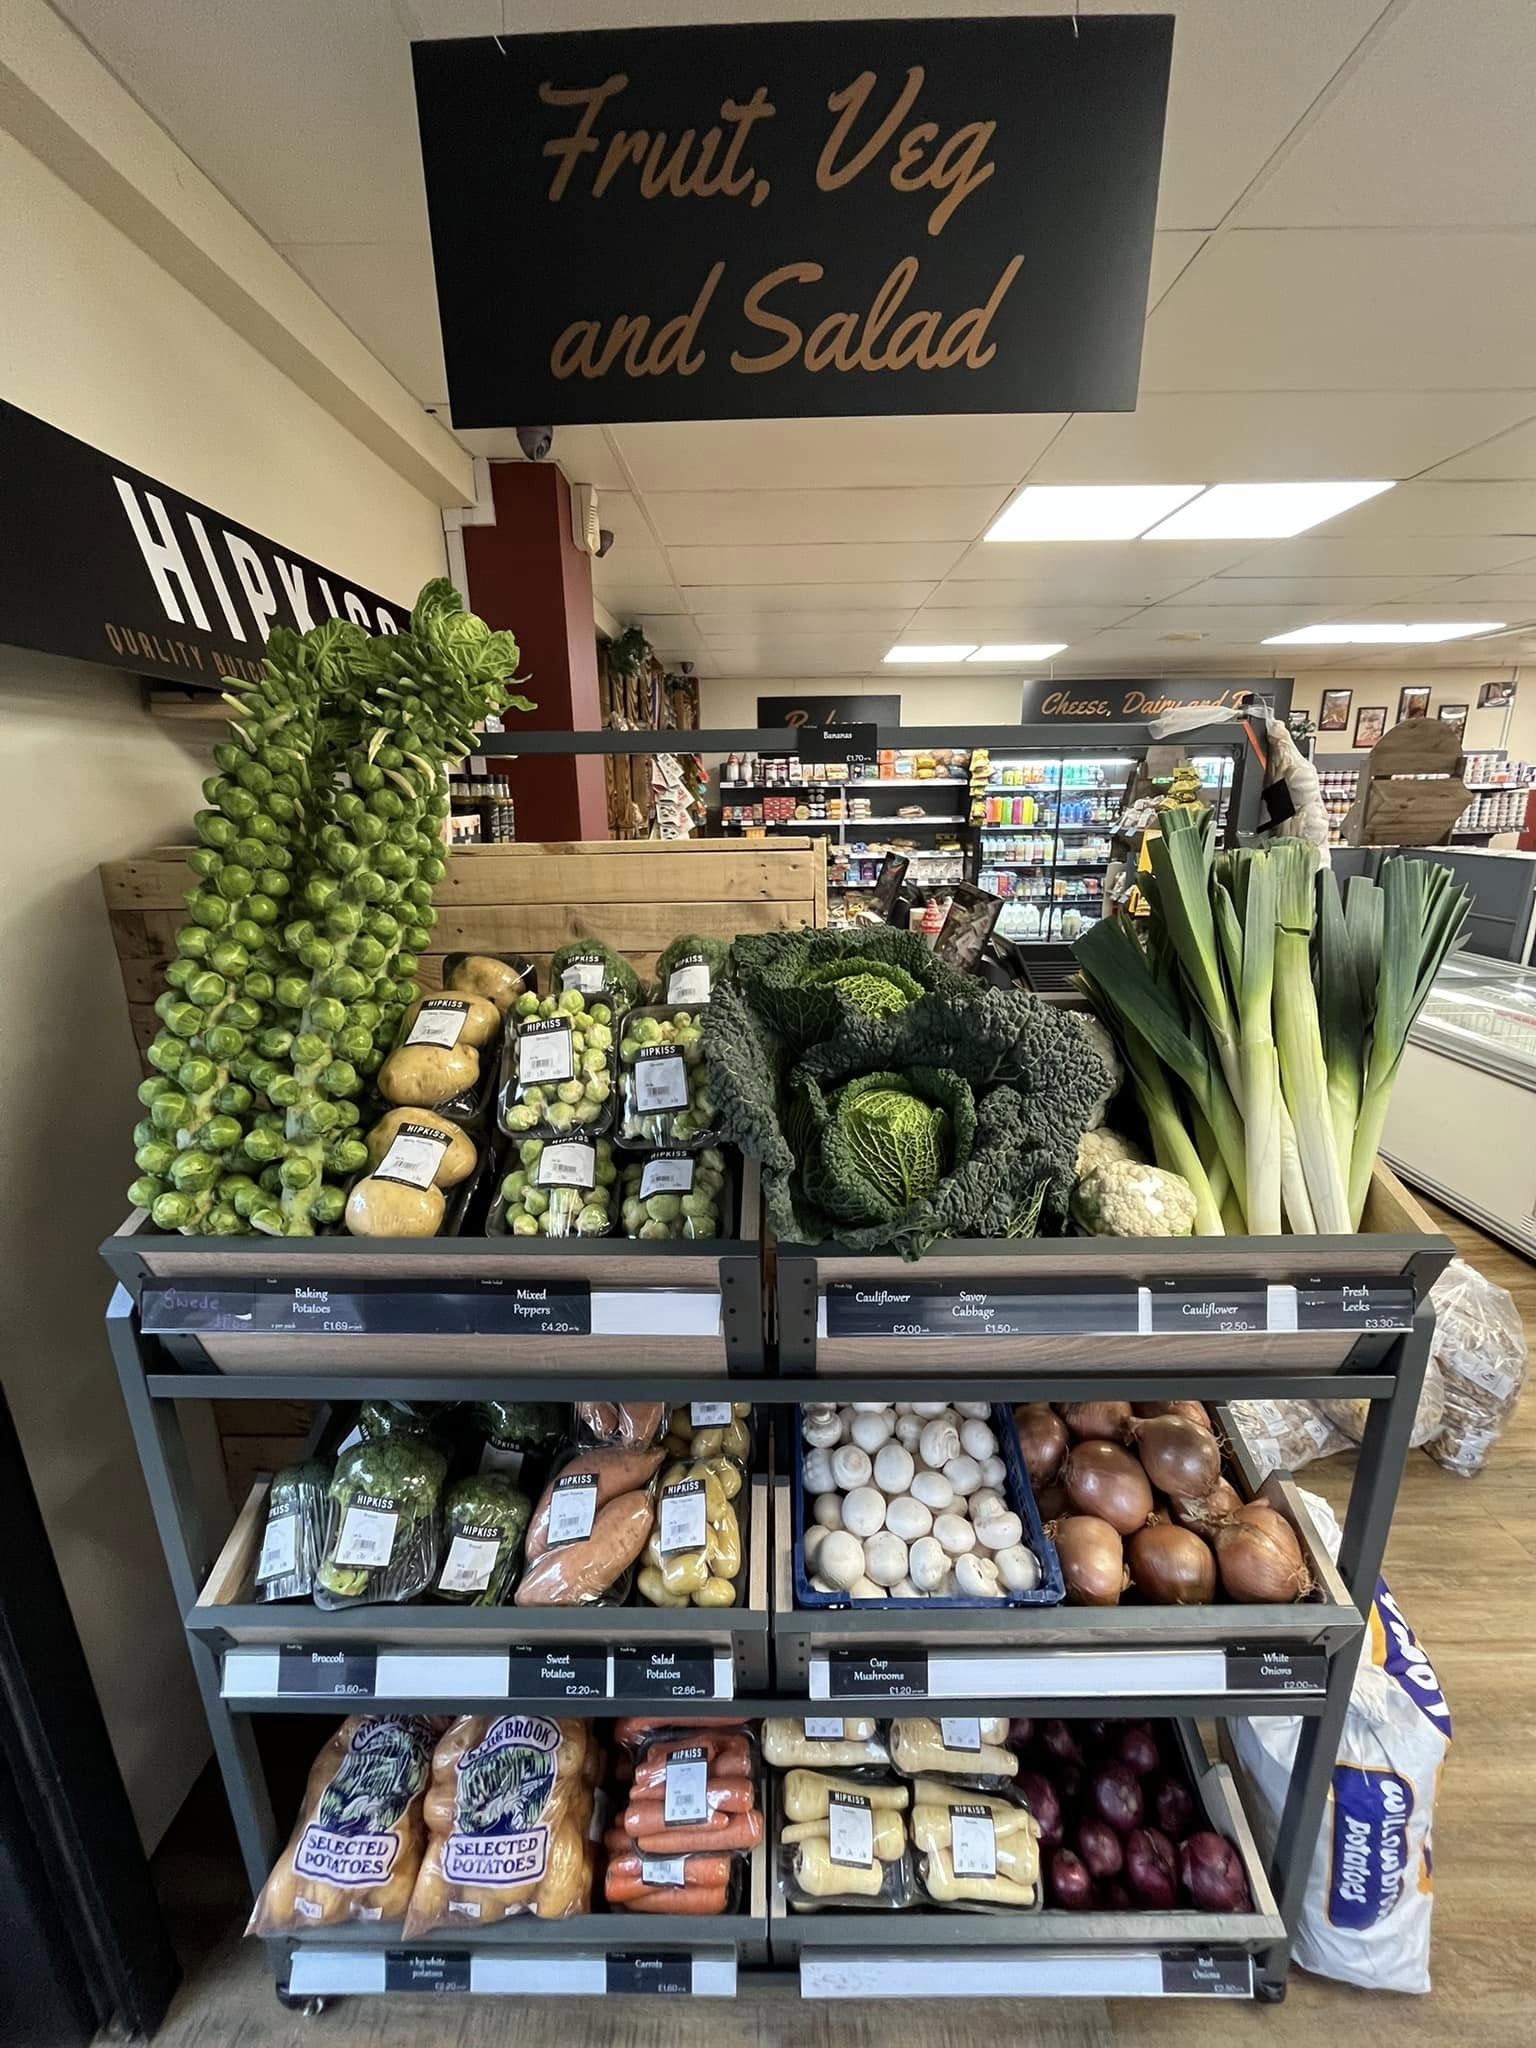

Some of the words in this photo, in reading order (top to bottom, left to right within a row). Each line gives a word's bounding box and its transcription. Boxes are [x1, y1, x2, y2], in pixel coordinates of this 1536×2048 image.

[539, 73, 775, 207] Fruit,
[815, 65, 997, 236] Veg
[550, 260, 726, 380] and
[730, 254, 1025, 375] Salad
[104, 622, 205, 671] QUALITY
[1041, 690, 1112, 717] Cheese,
[823, 731, 853, 739] Bananas
[428, 1000, 464, 1010] HIPKISS
[526, 1018, 562, 1032] HIPKISS
[641, 1045, 676, 1057] HIPKISS
[406, 1124, 446, 1141] HIPKISS
[650, 1150, 687, 1160] HIPKISS
[295, 1288, 329, 1301] Baking
[517, 1288, 547, 1300] Mixed
[1342, 1285, 1369, 1297] Fresh
[855, 1291, 911, 1306] Cauliflower
[959, 1291, 987, 1304] Savoy
[292, 1303, 331, 1314] Potatoes
[513, 1304, 550, 1317] Peppers
[952, 1306, 995, 1320] Cabbage
[1182, 1303, 1239, 1318] Cauliflower
[1342, 1301, 1370, 1313] Leeks
[541, 1322, 568, 1332] £4.20
[893, 1324, 921, 1334] £2.00
[985, 1324, 1011, 1333] £1.50
[1220, 1322, 1248, 1332] £2.50
[1365, 1319, 1393, 1328] £3.30
[559, 1474, 593, 1486] HIPKISS
[667, 1481, 700, 1494] HIPKISS
[356, 1494, 395, 1511] HIPKISS
[462, 1525, 499, 1538] HIPKISS
[311, 1651, 345, 1663] Broccoli
[546, 1654, 570, 1665] Sweet
[651, 1653, 675, 1665] Salad
[1263, 1653, 1289, 1662] White
[869, 1657, 888, 1670] Cup
[541, 1668, 575, 1679] Potatoes
[646, 1669, 681, 1679] Potatoes
[853, 1670, 905, 1681] Mushrooms
[1260, 1666, 1293, 1675] Onions
[334, 1684, 359, 1694] £3.60
[566, 1685, 590, 1695] £2.20
[889, 1686, 912, 1696] £1.20
[1284, 1681, 1308, 1689] £2.00
[672, 1748, 703, 1758] HIPKISS
[834, 1791, 865, 1804] HIPKISS
[954, 1804, 987, 1816] HIPKISS
[307, 1834, 389, 1857] SELECTED
[454, 1837, 539, 1857] SELECTED
[305, 1851, 384, 1875] POTATOES
[452, 1855, 537, 1875] POTATOES
[1339, 1816, 1372, 1904] potatoes
[634, 1959, 664, 1969] Carrots
[412, 1967, 444, 1979] potatoes
